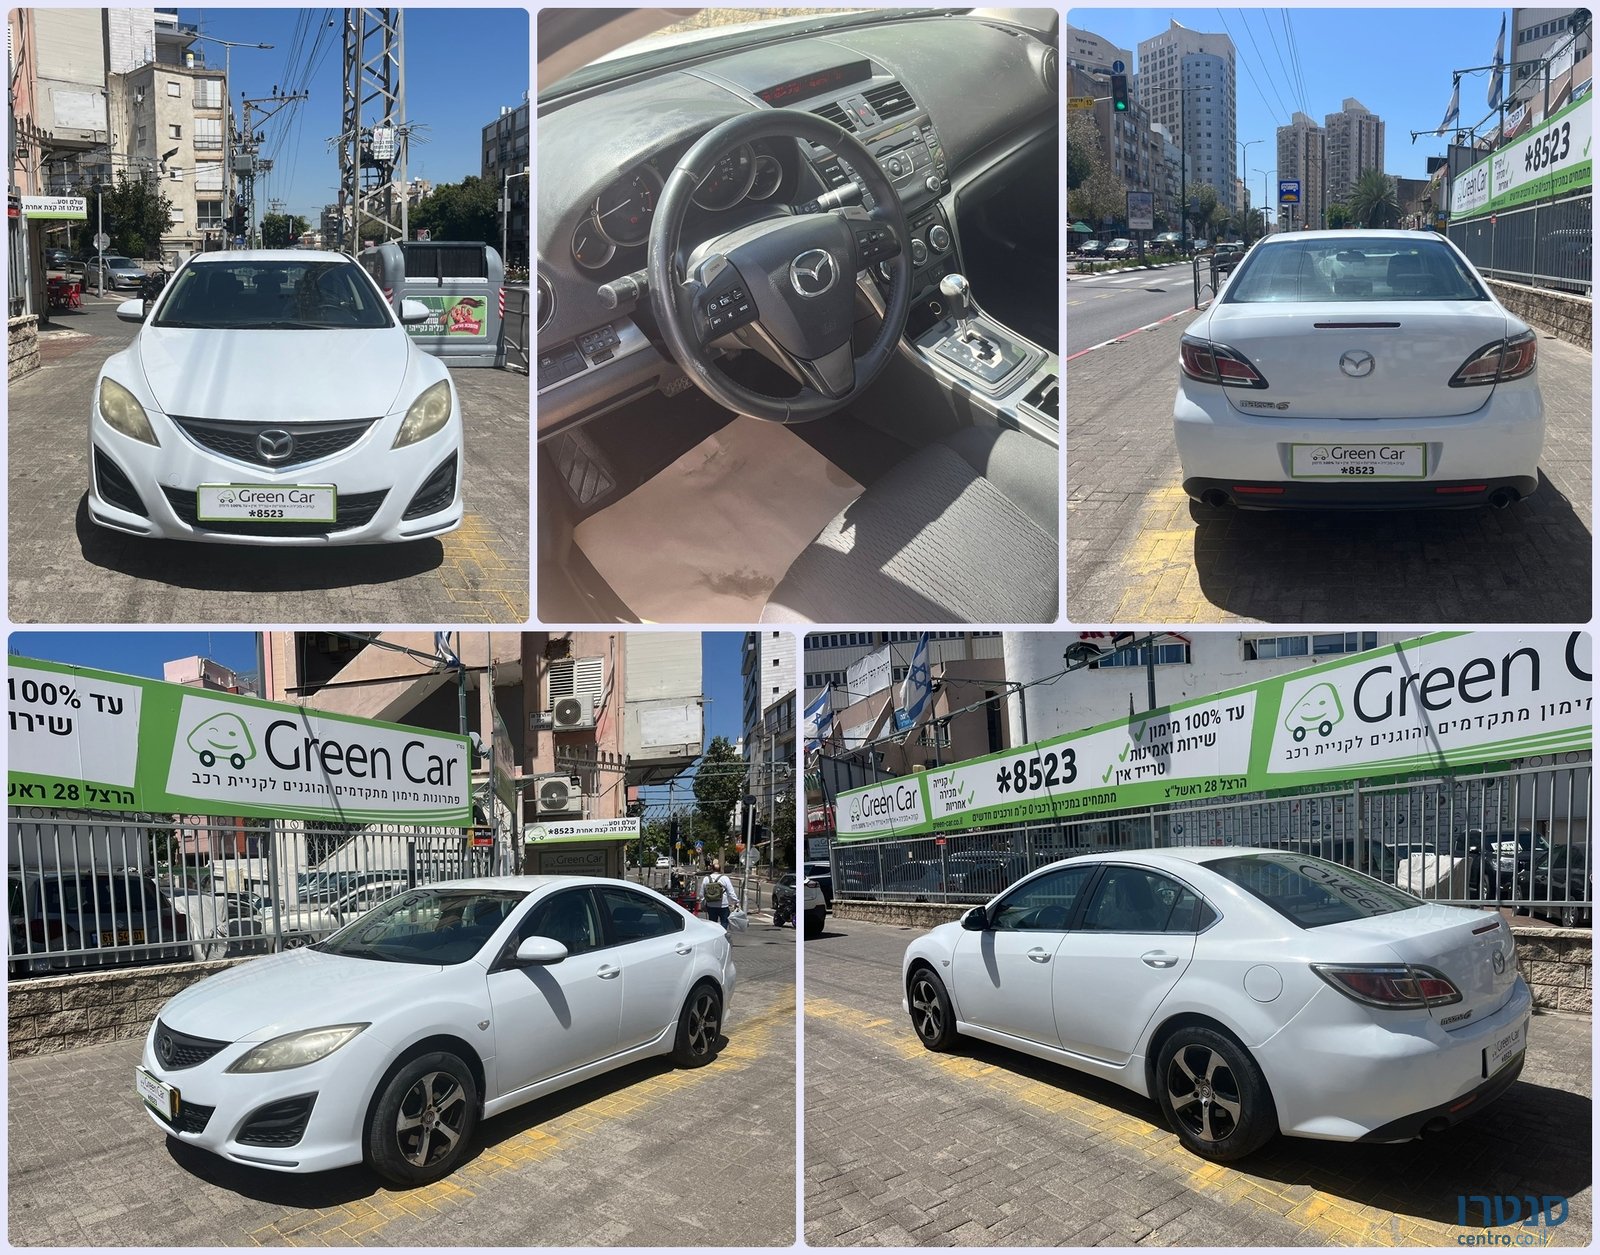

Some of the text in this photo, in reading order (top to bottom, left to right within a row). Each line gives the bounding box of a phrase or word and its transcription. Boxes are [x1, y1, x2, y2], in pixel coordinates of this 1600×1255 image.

[1331, 446, 1405, 460] Green Car
[238, 490, 315, 503] Green Car
[1353, 647, 1540, 724] Green
[8, 678, 123, 715] עד 100%
[8, 711, 72, 736] שירו
[1149, 705, 1245, 742] עד 100% מימון
[1439, 706, 1529, 735] מתקדמים
[1370, 726, 1428, 746] והוגנים
[1130, 732, 1216, 762] שירות ואמינות
[1315, 735, 1362, 755] לקניית
[265, 720, 457, 786] Green Car
[1286, 746, 1309, 760] רכב
[1115, 762, 1165, 786] טרייד אין
[192, 772, 460, 805] פתרונות מימון מתקדמים והוגנים לקניית רכב
[933, 777, 948, 789] קנייה
[1204, 780, 1217, 792] 28
[1219, 778, 1247, 790] הרצל
[53, 783, 79, 800] 28
[86, 784, 134, 804] הרצל
[940, 789, 956, 799] מכירה
[1082, 791, 1116, 806] מתמחים
[862, 786, 917, 817] Green Car
[946, 801, 966, 811] אחריות
[1034, 802, 1050, 812] רכבי
[1054, 798, 1080, 812] במכירת
[972, 812, 991, 822] חדשים
[993, 809, 1013, 819] ורכבים
[1029, 805, 1034, 814] 0
[556, 854, 602, 864] Green Car
